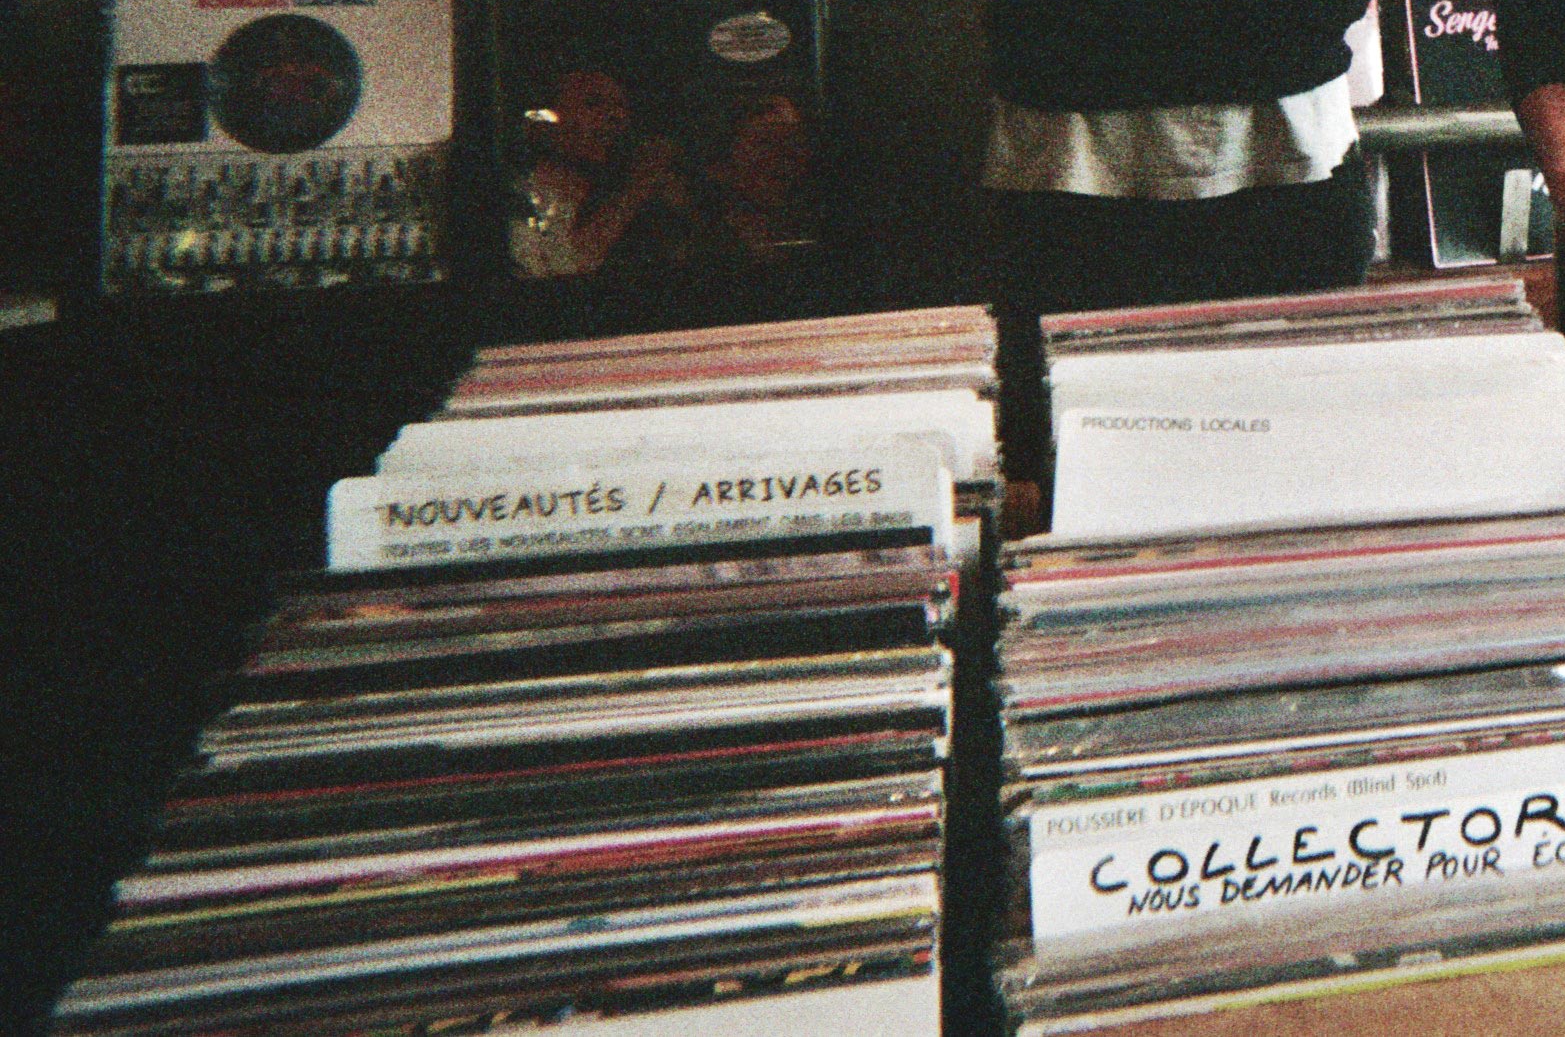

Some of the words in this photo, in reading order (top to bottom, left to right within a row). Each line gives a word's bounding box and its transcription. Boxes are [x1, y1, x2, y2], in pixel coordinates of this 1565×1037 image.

[1080, 415, 1195, 434] PRODUCTIONS
[1199, 416, 1273, 435] LOCALES
[384, 478, 626, 527] NOUVEAUTÉS
[692, 466, 884, 508] ARRIVAGES
[1269, 782, 1338, 808] Records
[1346, 773, 1397, 800] (Blind
[1405, 769, 1449, 793] Spot)
[1127, 883, 1202, 917] NOUS
[1220, 857, 1405, 905] DEMANDER
[1425, 849, 1504, 881] POUR
